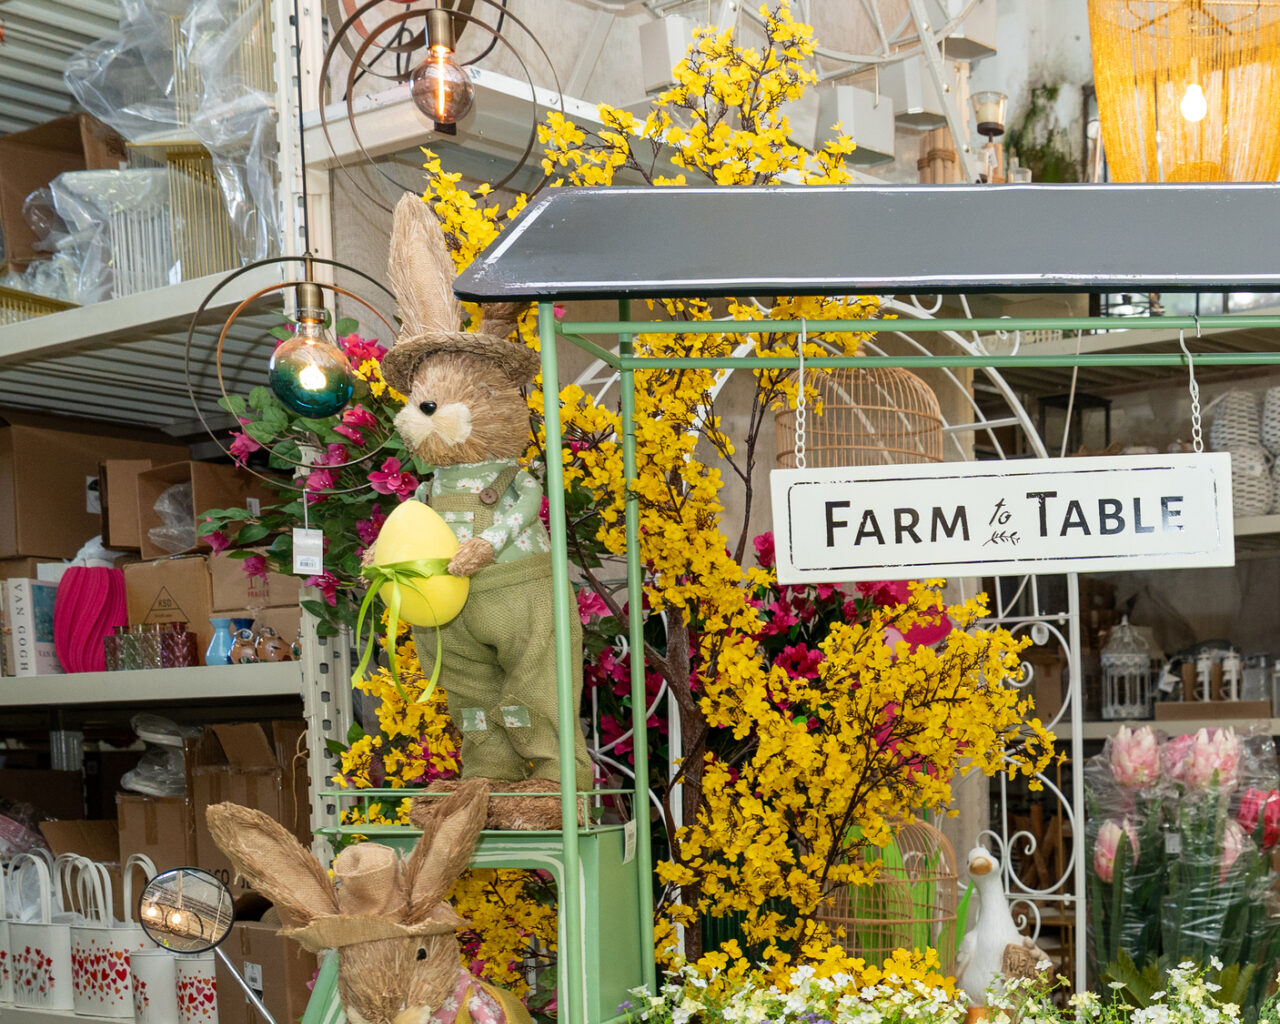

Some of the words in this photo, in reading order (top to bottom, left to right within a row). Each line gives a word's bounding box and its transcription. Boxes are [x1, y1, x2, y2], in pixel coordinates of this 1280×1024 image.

[825, 500, 970, 547] FARM
[988, 498, 1012, 526] to
[1026, 490, 1184, 538] TABLE
[14, 583, 25, 616] VAN
[18, 625, 29, 671] GOGH
